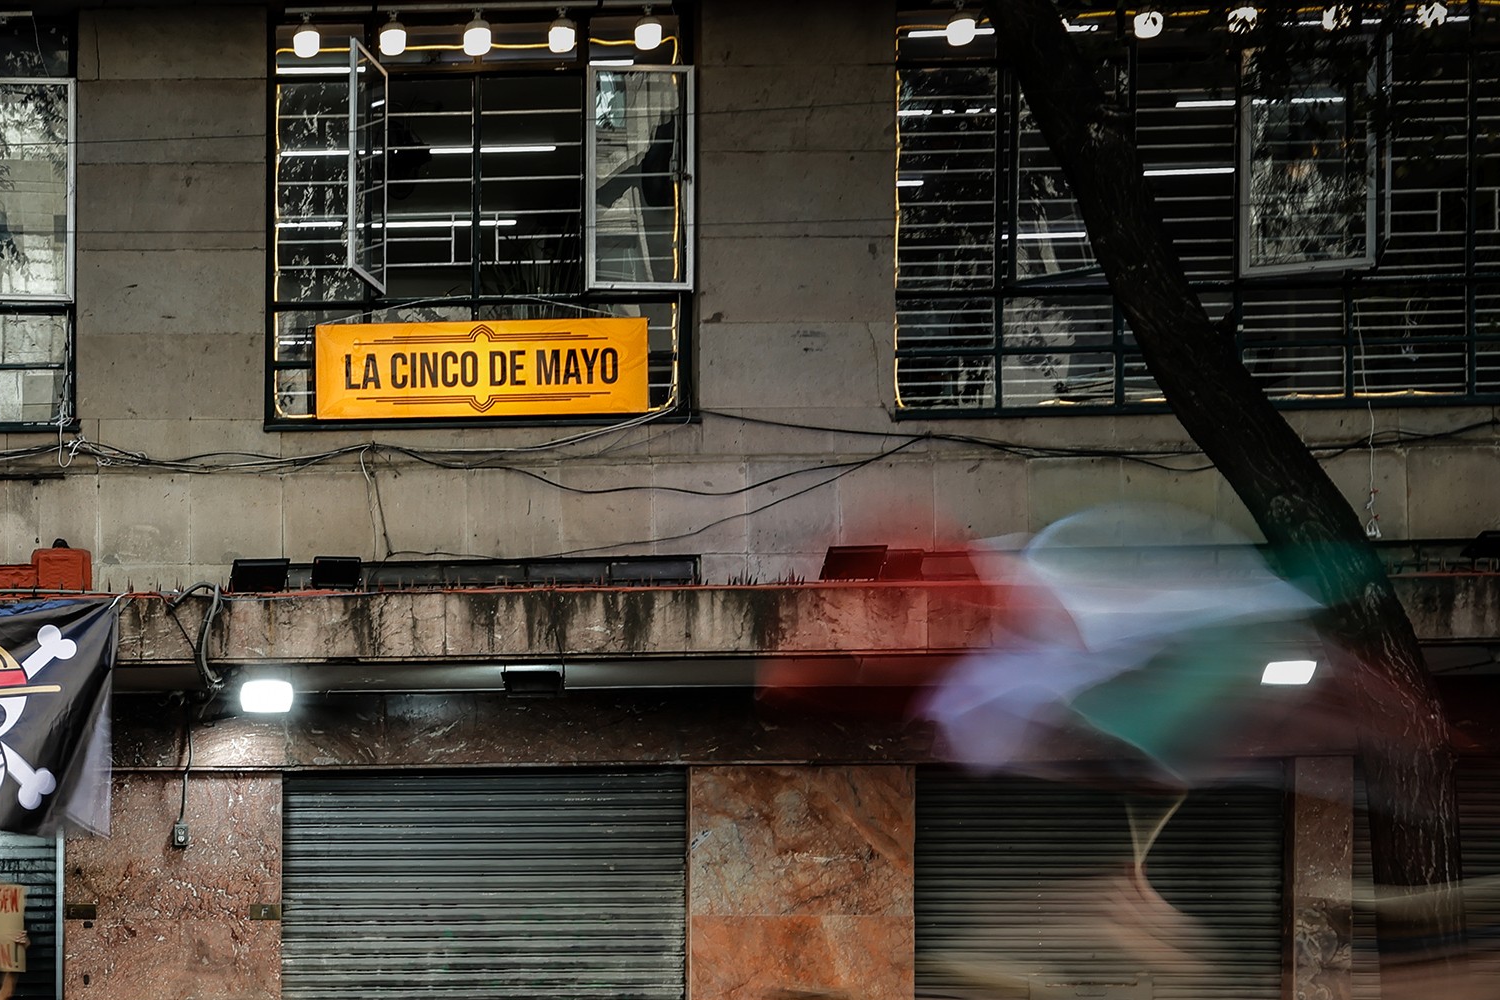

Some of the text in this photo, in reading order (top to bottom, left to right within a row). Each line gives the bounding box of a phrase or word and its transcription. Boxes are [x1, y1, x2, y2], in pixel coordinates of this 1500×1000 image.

[344, 347, 620, 390] LA CINCO DE MAYO
[261, 907, 269, 917] F
